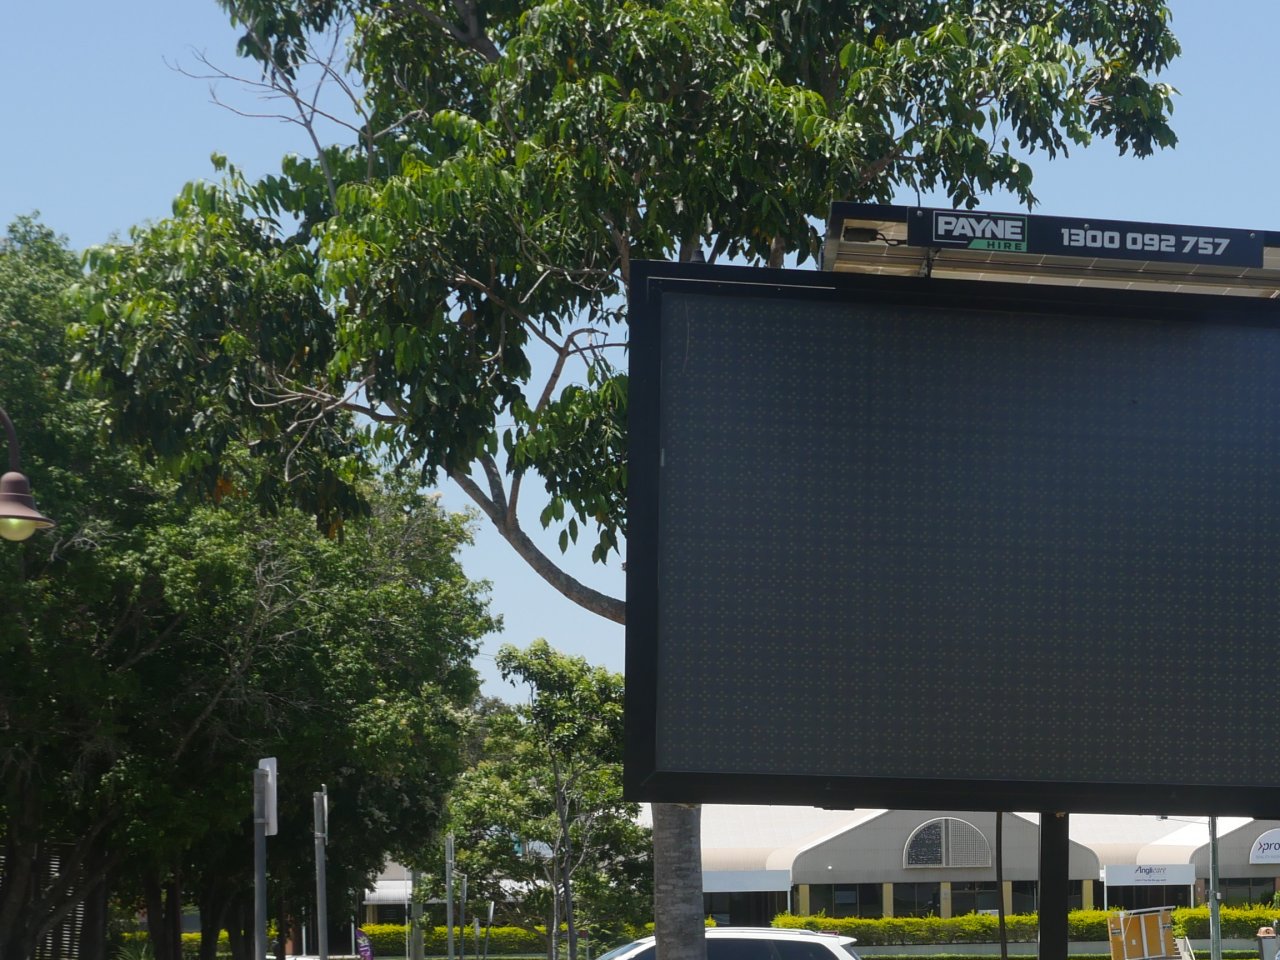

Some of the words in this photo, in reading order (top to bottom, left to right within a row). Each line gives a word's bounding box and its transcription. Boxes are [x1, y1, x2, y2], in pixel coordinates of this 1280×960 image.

[938, 216, 1023, 240] PAYNE
[986, 241, 1023, 250] HIRE
[1061, 228, 1120, 249] 1300
[1126, 232, 1176, 252] 092
[1181, 236, 1231, 256] 757
